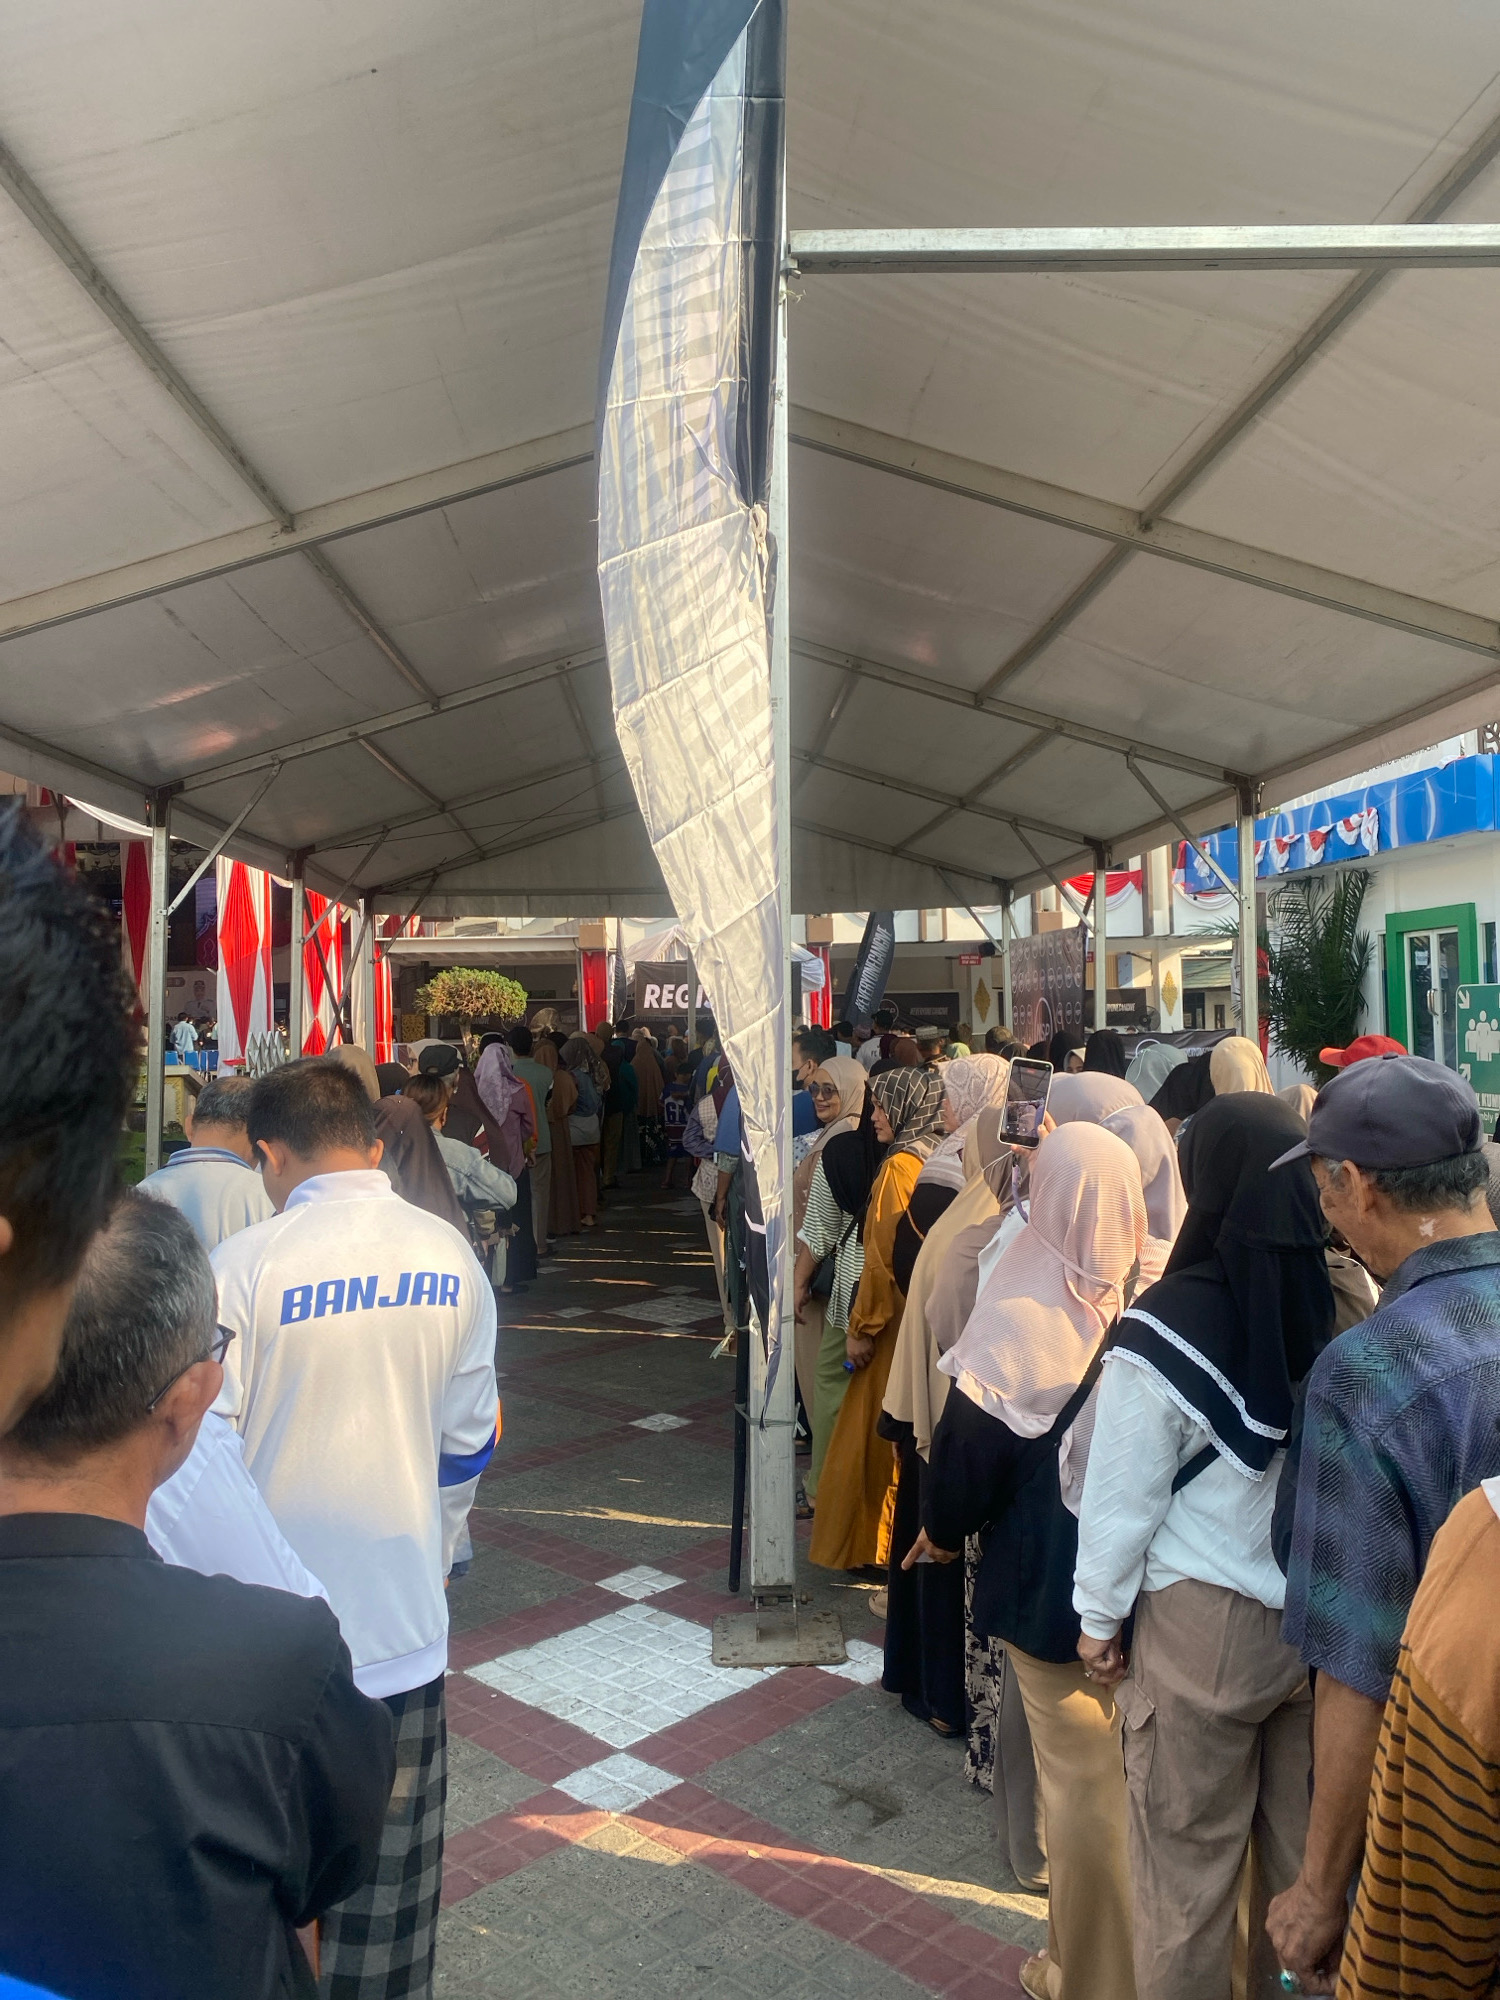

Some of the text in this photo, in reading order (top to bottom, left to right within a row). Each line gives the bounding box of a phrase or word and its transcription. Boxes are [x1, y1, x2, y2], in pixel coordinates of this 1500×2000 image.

[854, 923, 892, 1014] #EVERYONECANGIVE
[643, 983, 711, 1009] REGI
[280, 1272, 460, 1326] BANJAR
